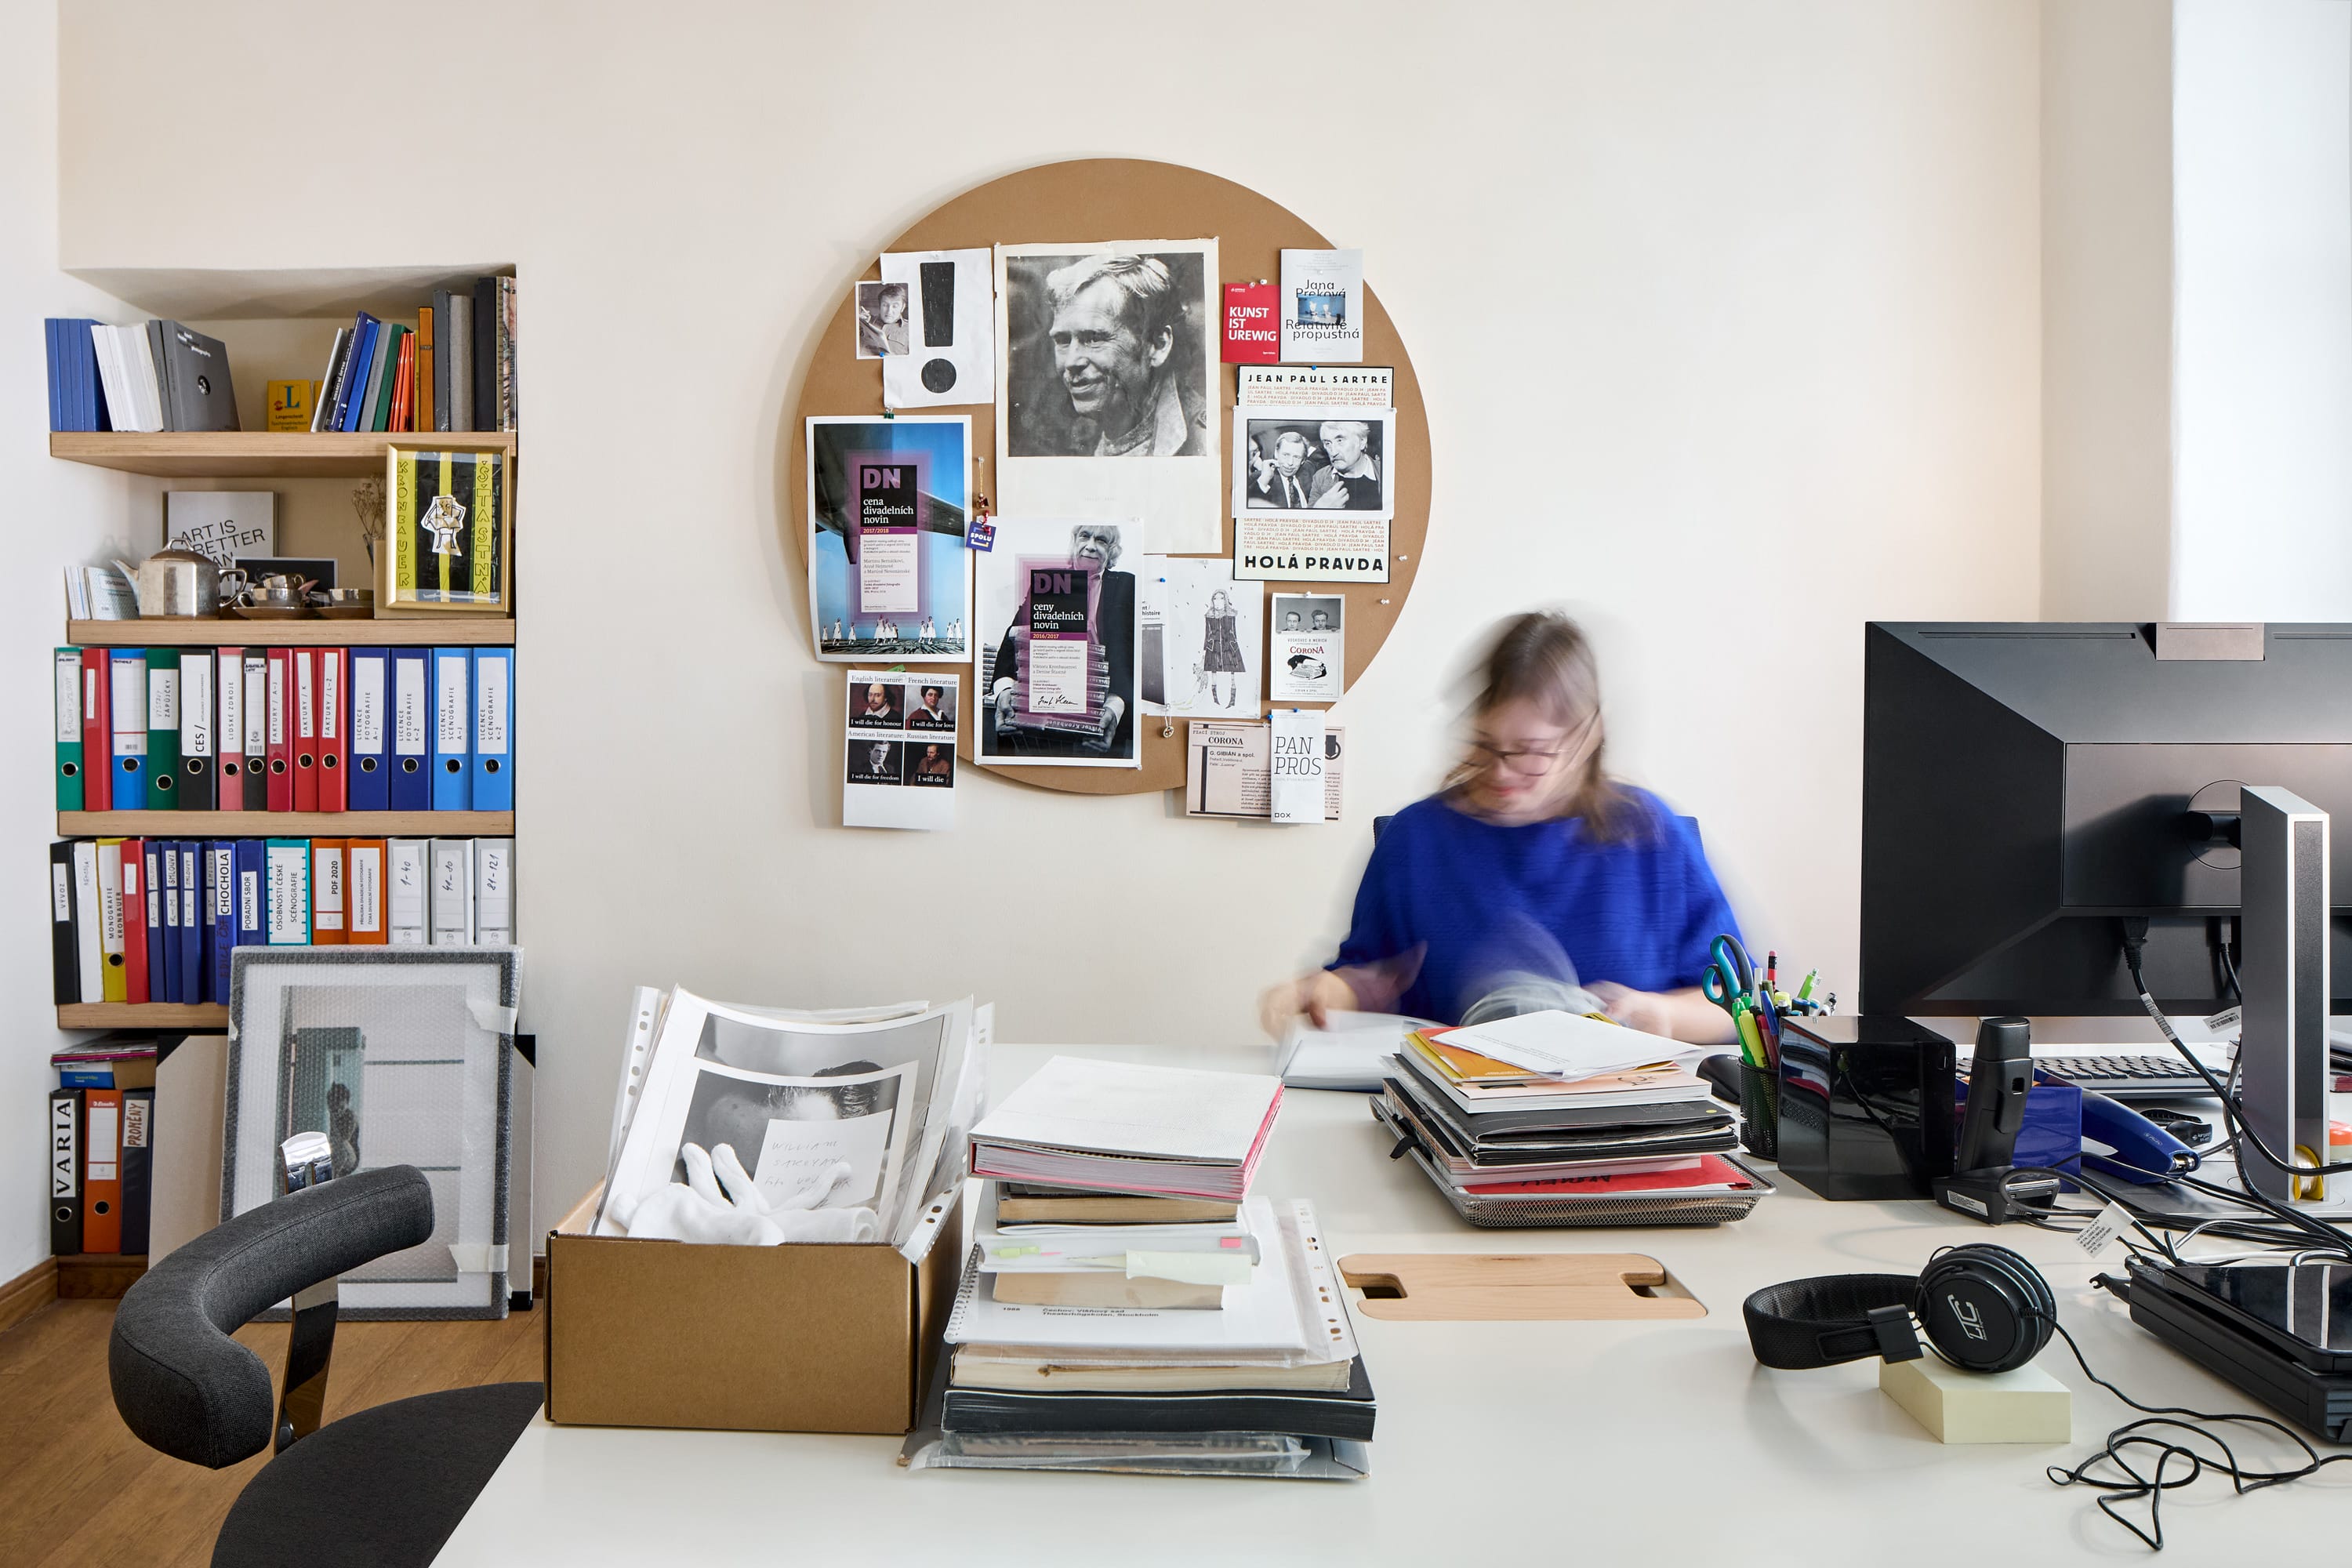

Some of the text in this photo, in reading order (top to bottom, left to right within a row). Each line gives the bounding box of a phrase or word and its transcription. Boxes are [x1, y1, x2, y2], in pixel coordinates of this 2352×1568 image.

[1305, 279, 1334, 290] Jana
[1229, 307, 1269, 318] KUNST
[1229, 318, 1246, 329] IST
[1229, 330, 1276, 341] UREWIG
[1294, 328, 1359, 341] propustná
[1290, 375, 1326, 383] PAUL
[285, 386, 299, 408] L
[864, 468, 901, 489] DN
[863, 506, 914, 514] divadelních
[397, 461, 410, 586] KRONBAUER
[864, 515, 889, 524] novin
[180, 519, 236, 545] ART IS
[971, 532, 992, 542] SPOLU
[193, 528, 266, 556] BETTER
[1245, 554, 1383, 571] HOLÁ PRAVDA
[1034, 573, 1071, 594] DN
[1033, 604, 1054, 612] ceny
[1033, 612, 1084, 620] divadelních
[196, 733, 205, 753] CES
[1274, 736, 1313, 755] PAN
[1274, 757, 1322, 775] PROS
[220, 853, 230, 915] CHOCHOLA
[126, 1102, 145, 1147] PROMĚNY
[56, 1101, 71, 1195] VARIA
